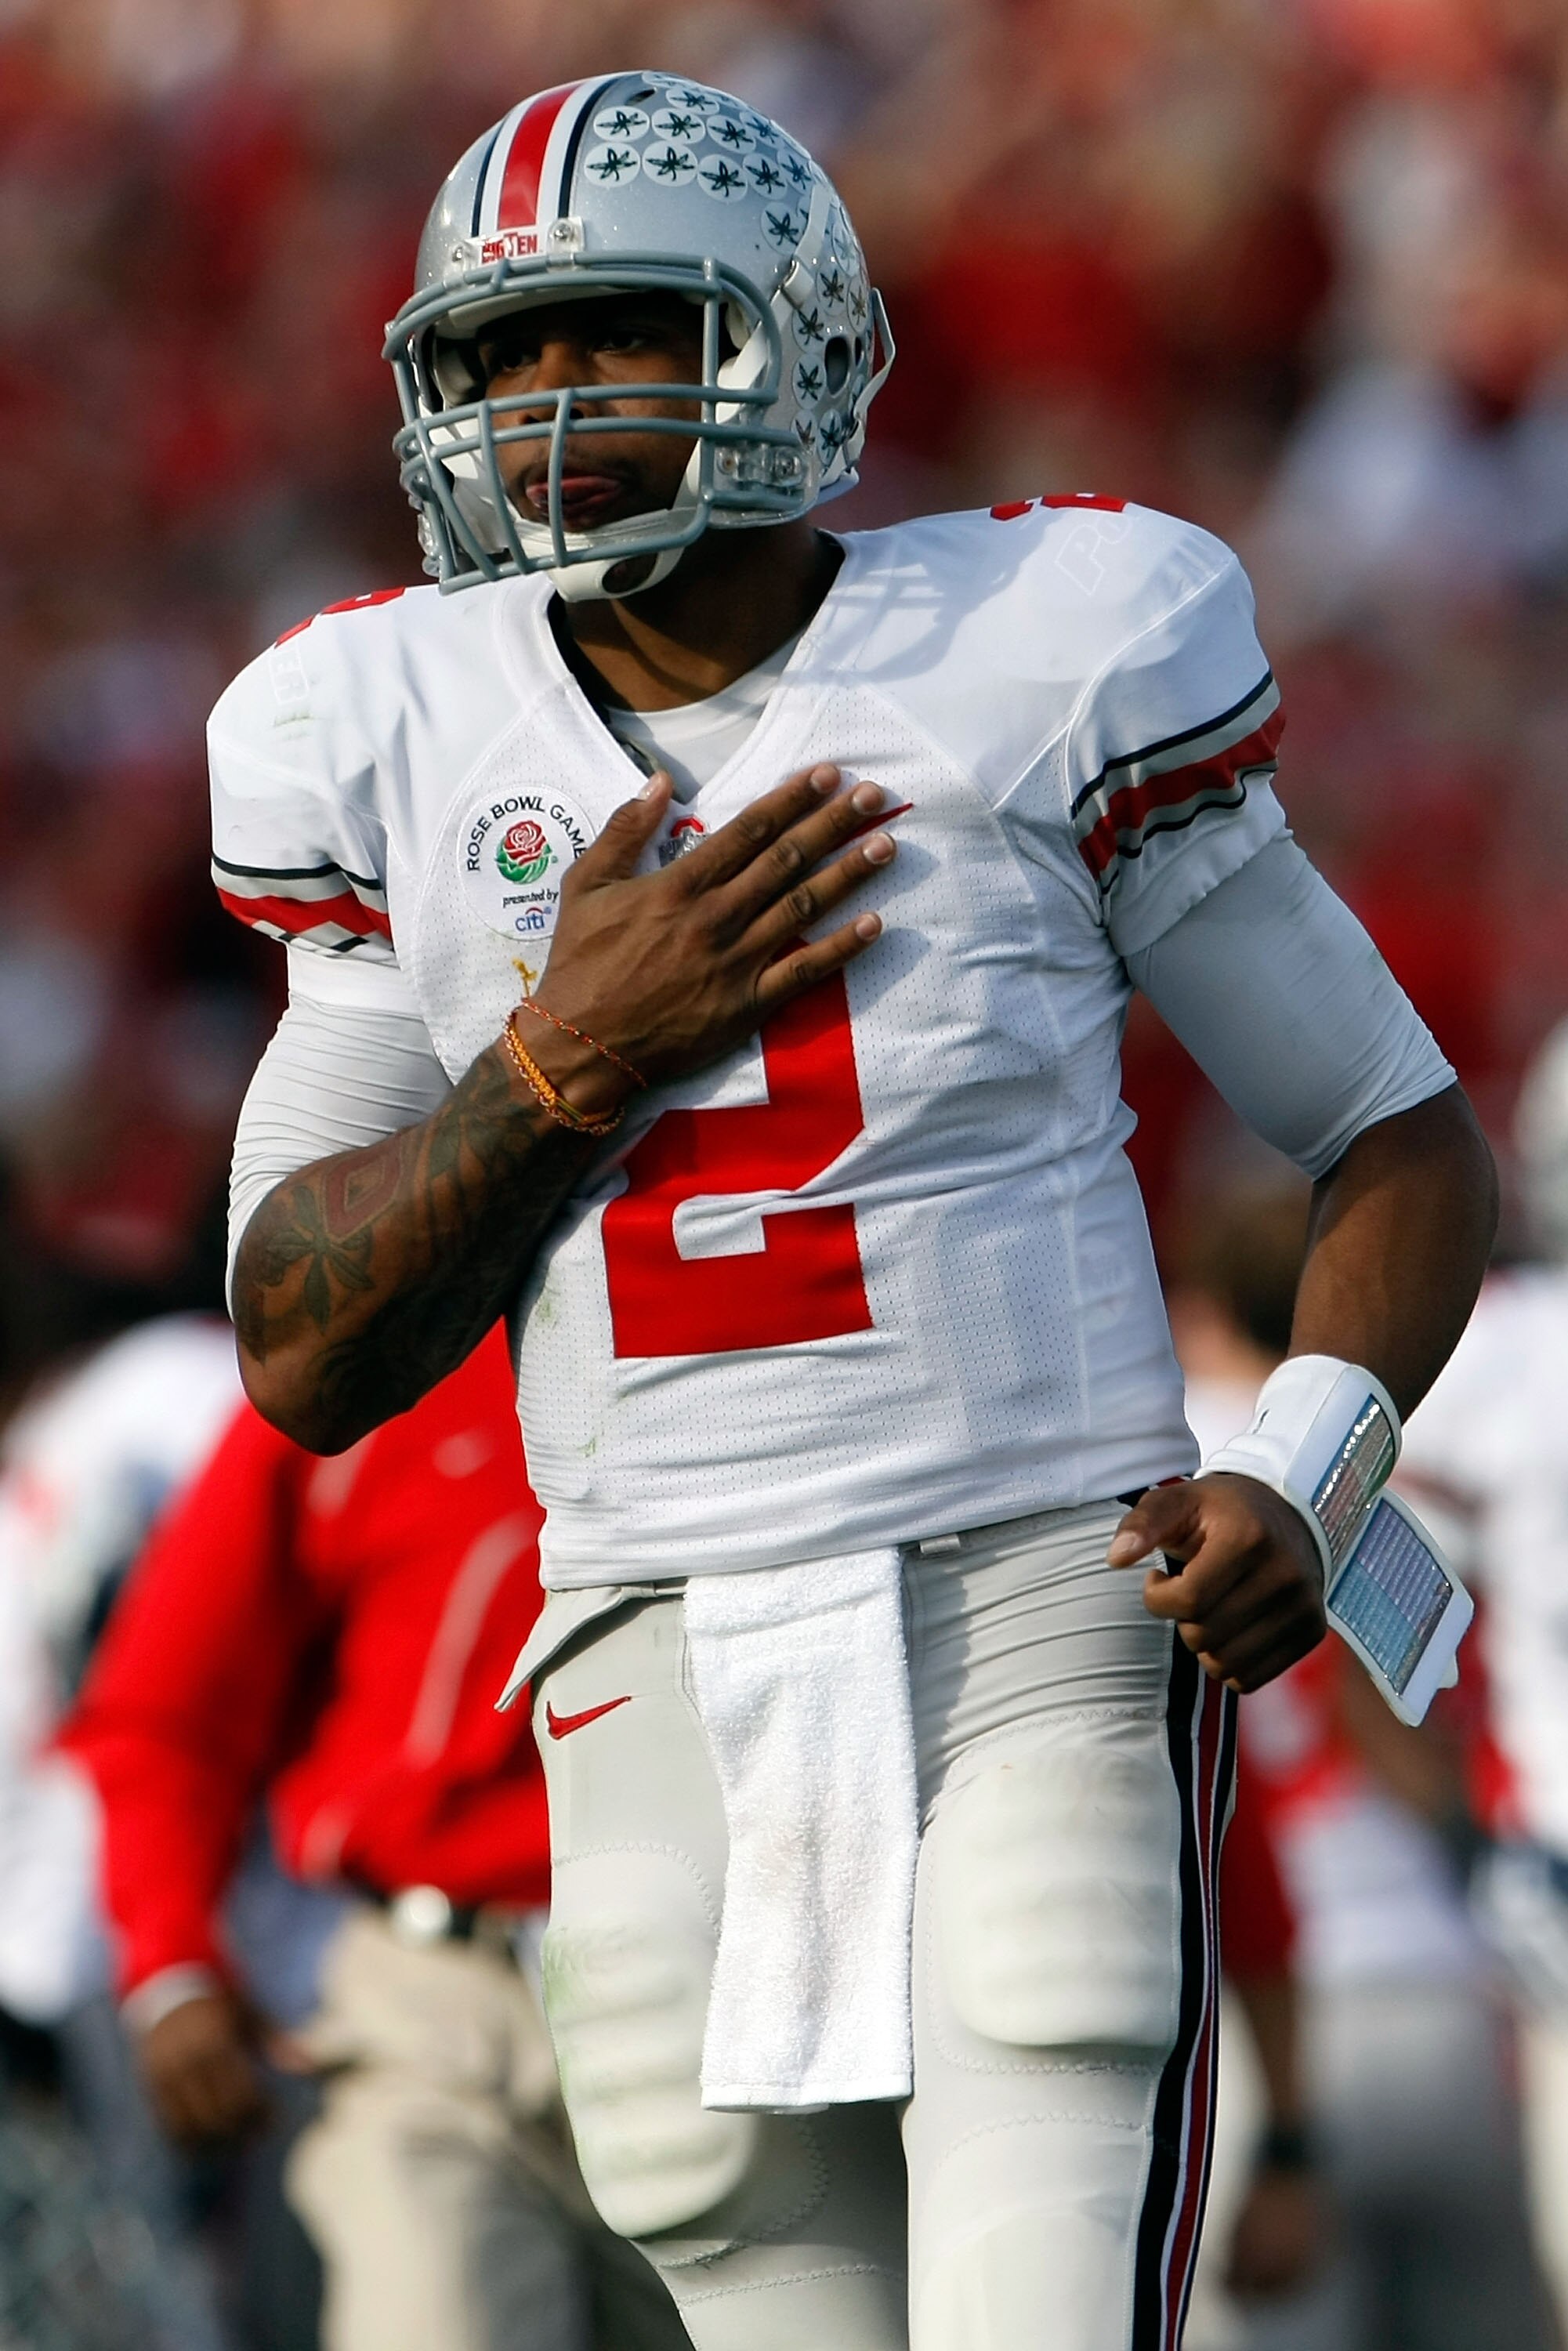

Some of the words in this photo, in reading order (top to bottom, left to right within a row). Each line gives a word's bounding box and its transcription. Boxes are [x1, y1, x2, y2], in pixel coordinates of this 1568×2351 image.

[466, 816, 491, 872] ROSE
[491, 796, 545, 820] BOWL
[550, 805, 587, 860] GAME
[502, 889, 545, 907] presented
[546, 888, 559, 904] by
[602, 938, 873, 1358] 2
